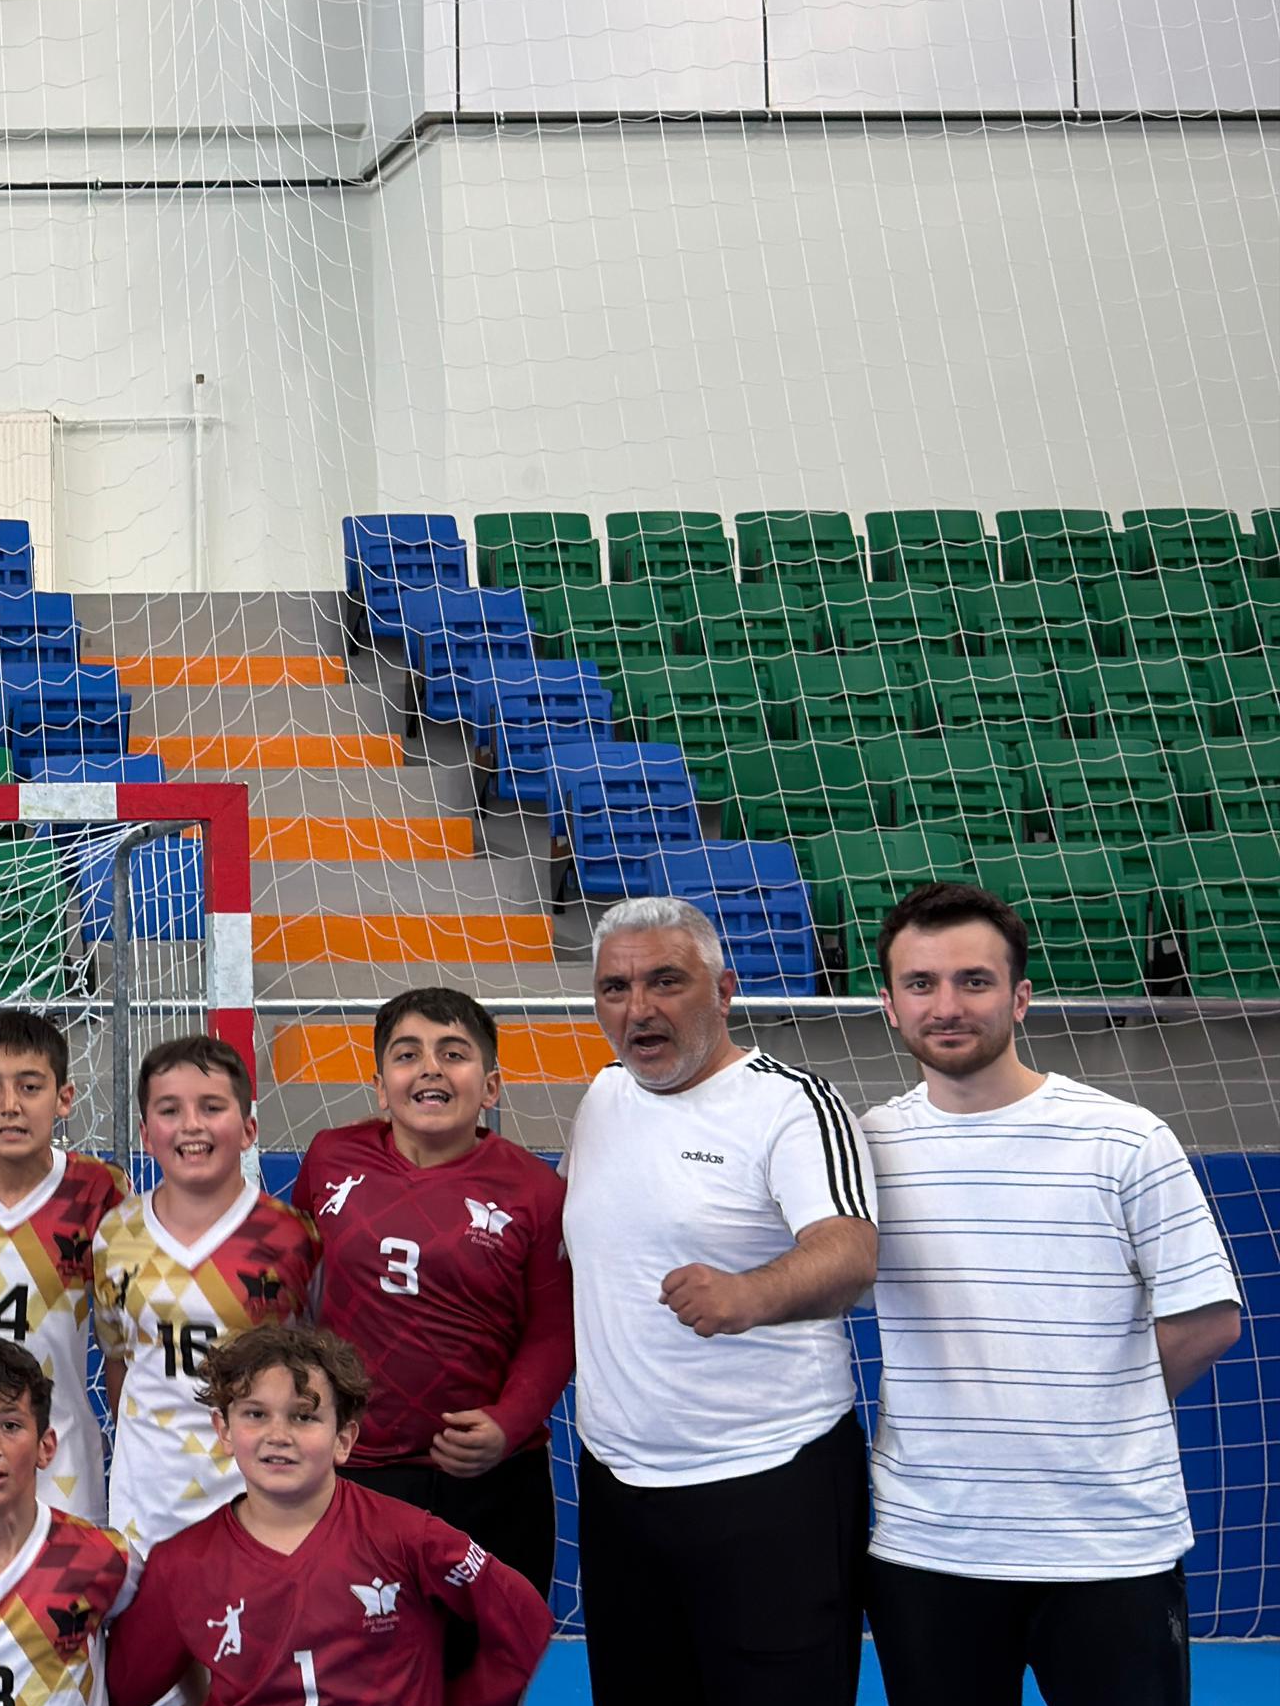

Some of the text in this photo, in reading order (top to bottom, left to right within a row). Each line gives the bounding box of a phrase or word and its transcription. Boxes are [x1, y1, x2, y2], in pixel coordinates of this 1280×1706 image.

[681, 1151, 724, 1164] adidas
[378, 1236, 421, 1296] 3
[156, 1321, 217, 1380] 16
